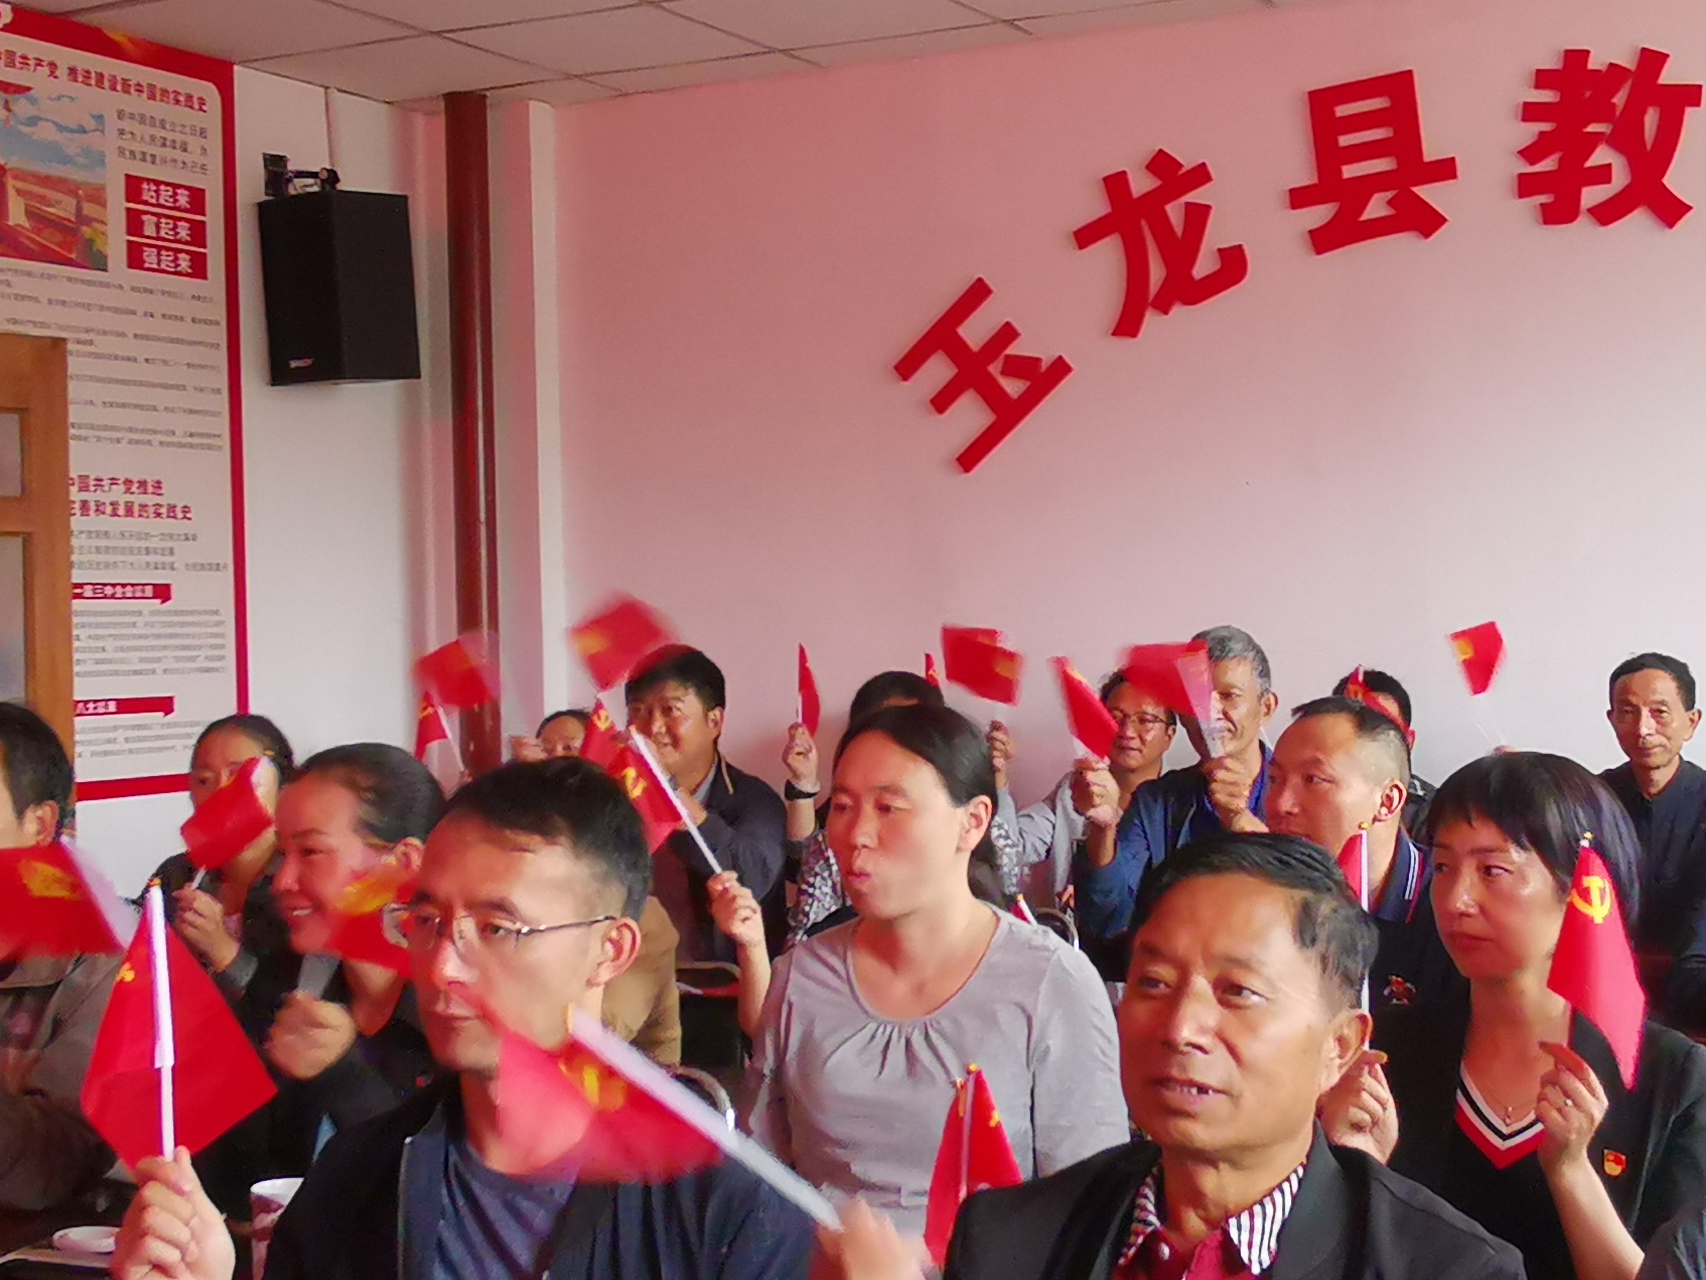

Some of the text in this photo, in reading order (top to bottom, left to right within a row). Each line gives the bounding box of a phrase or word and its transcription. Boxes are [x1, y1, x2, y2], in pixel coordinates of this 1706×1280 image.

[141, 181, 192, 210] 站起来
[141, 214, 192, 242] 富起来
[142, 246, 193, 274] 强起来
